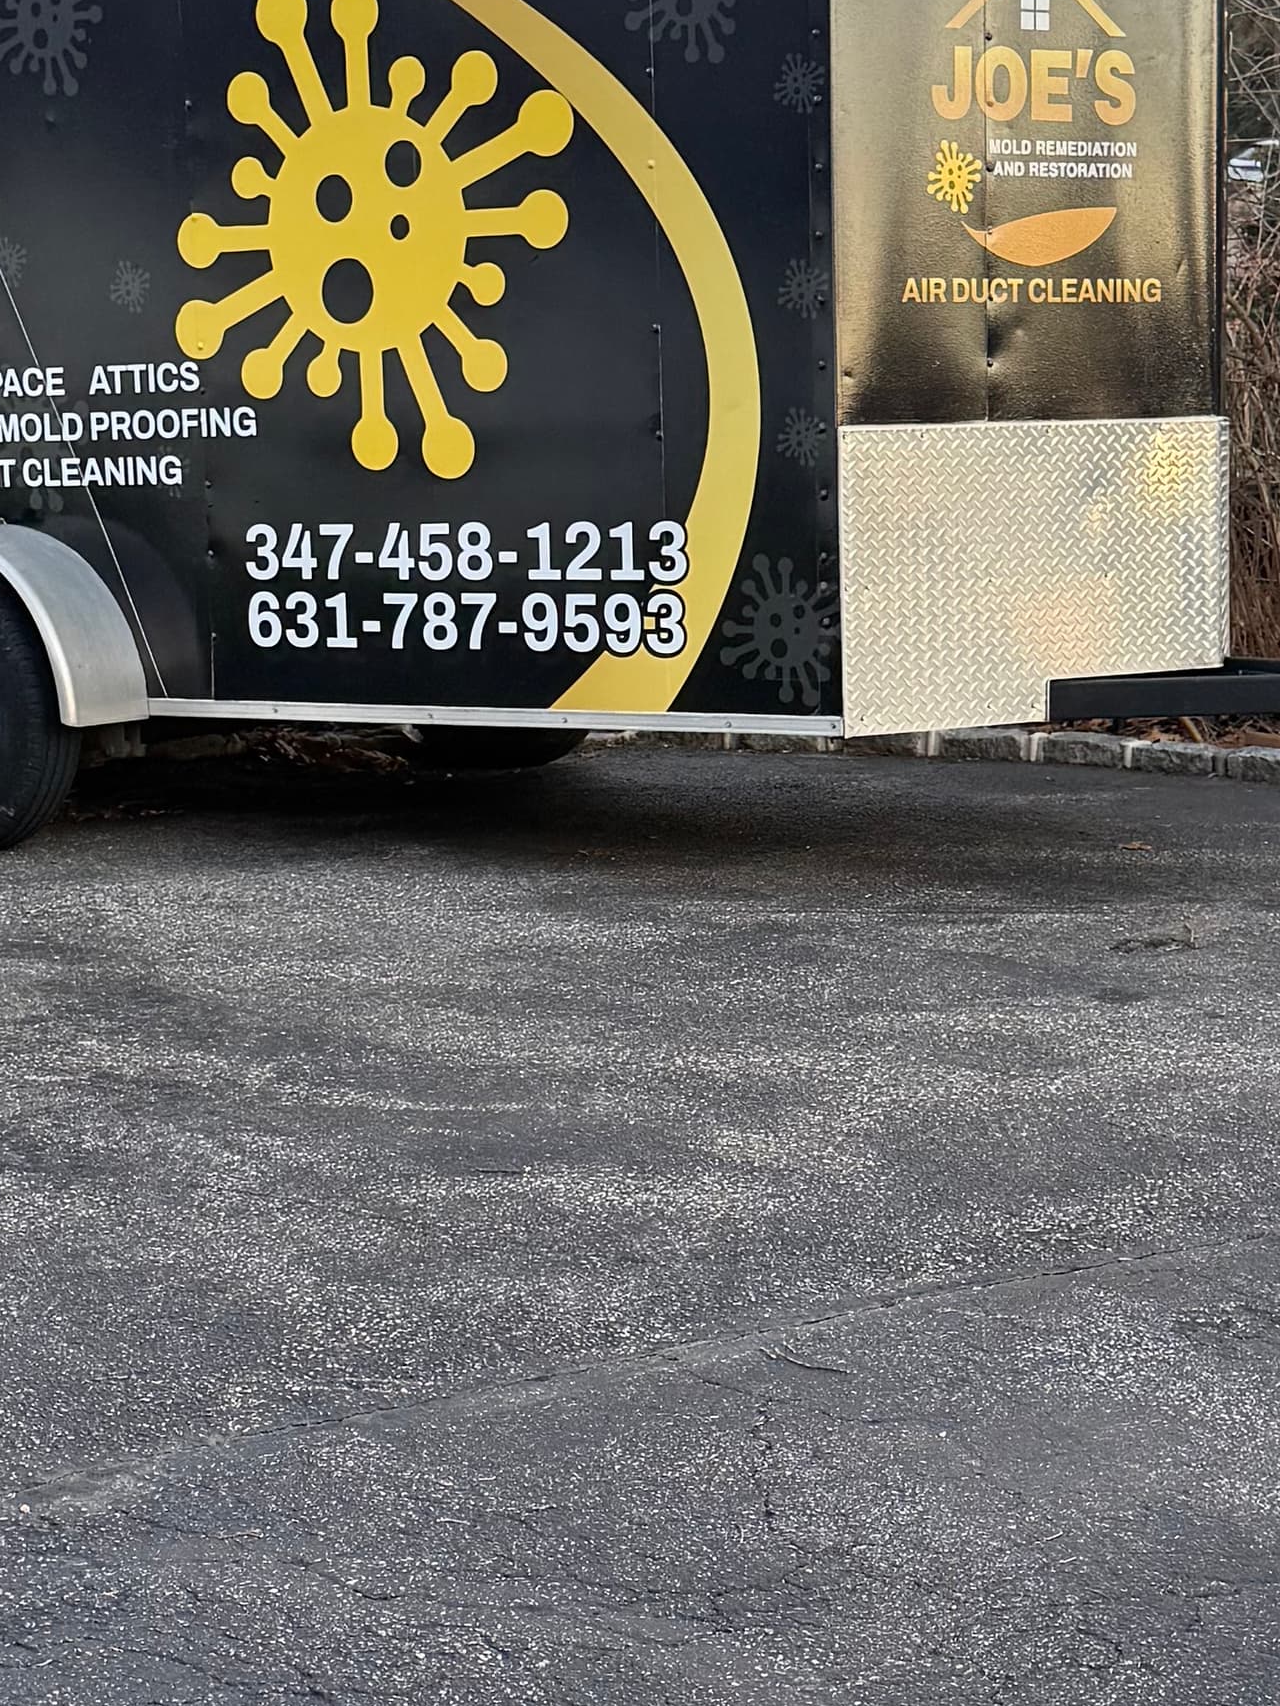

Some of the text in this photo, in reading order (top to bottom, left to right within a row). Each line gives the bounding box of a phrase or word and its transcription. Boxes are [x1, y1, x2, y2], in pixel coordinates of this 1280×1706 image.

[931, 44, 1137, 126] JOE'S
[989, 138, 1138, 157] MOLD REMEDIATION
[994, 160, 1133, 178] AND RESTORATION
[901, 278, 1162, 303] AIR DUCT CLEANING
[88, 362, 200, 395] ATTICS
[89, 407, 258, 441] PROOFING
[22, 455, 183, 487] CLEANING
[244, 519, 690, 583] 347-458-1213
[247, 589, 687, 654] 631-787-9593
